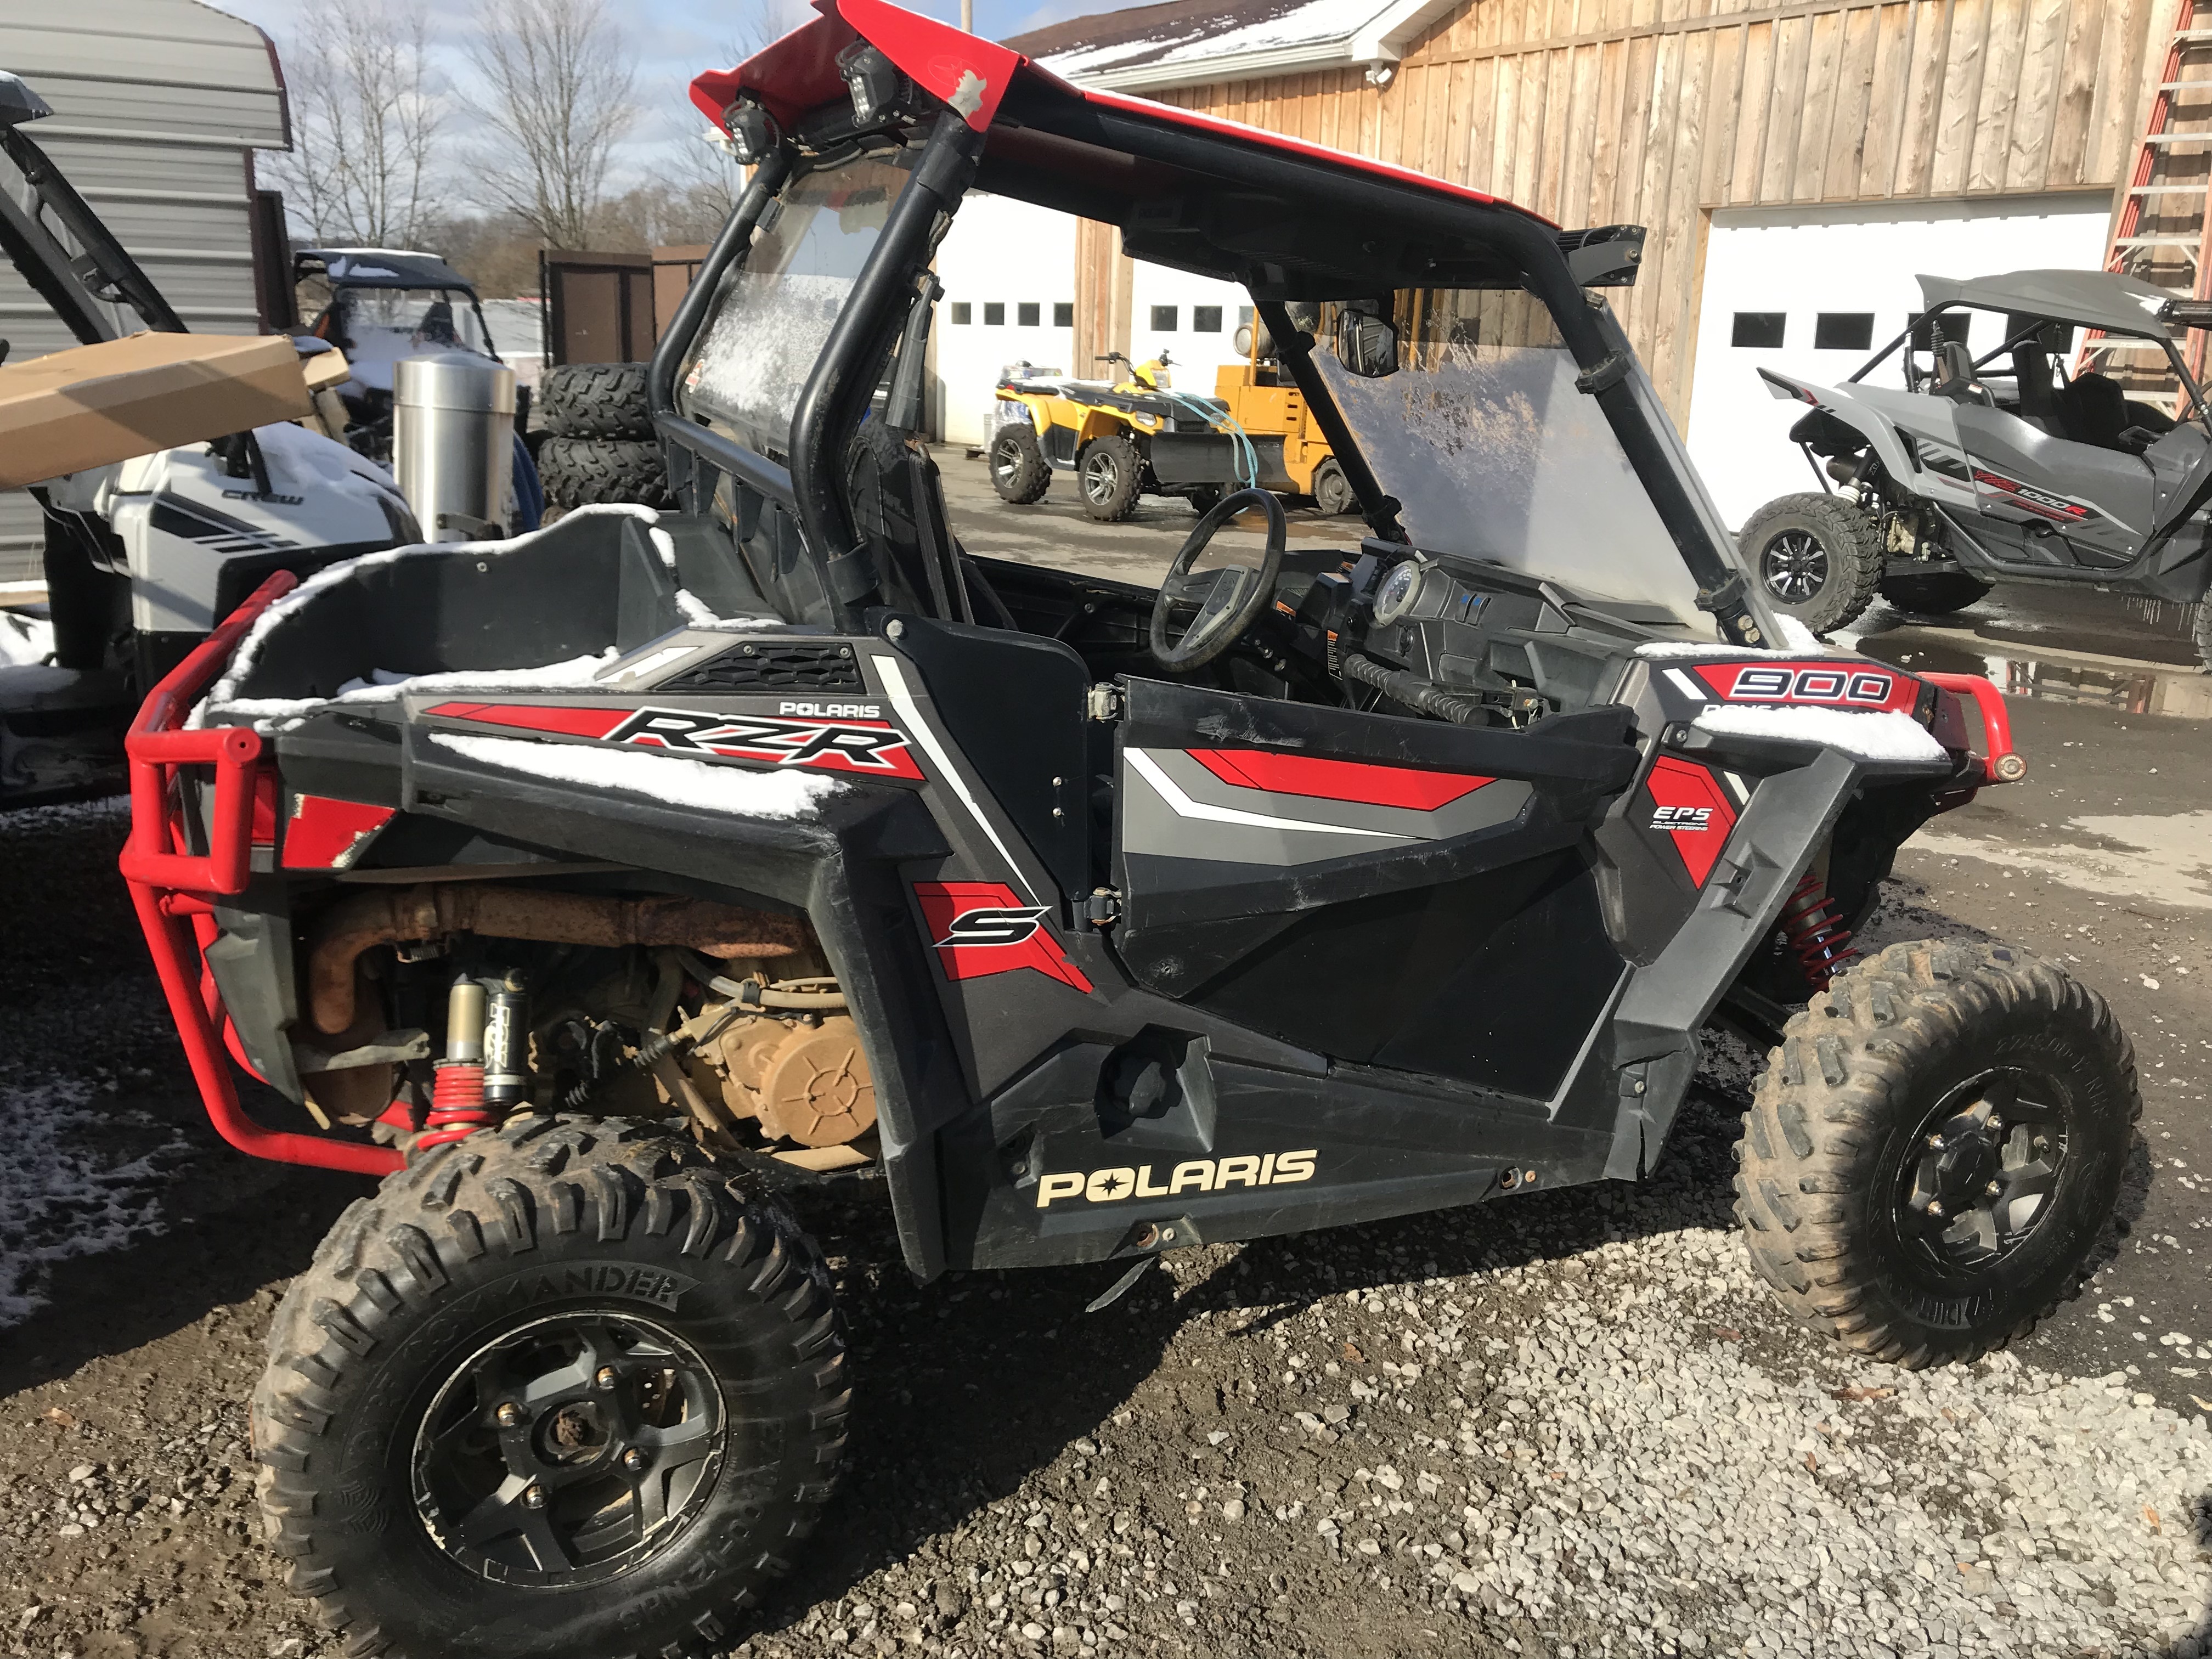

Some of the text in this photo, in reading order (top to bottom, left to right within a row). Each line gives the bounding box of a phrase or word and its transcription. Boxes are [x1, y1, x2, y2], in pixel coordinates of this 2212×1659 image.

[1728, 667, 1892, 704] 900
[779, 702, 880, 718] POLARIS
[601, 706, 911, 769] RZR
[1653, 806, 1713, 821] EPS
[932, 905, 1053, 948] S
[1036, 1149, 1318, 1207] POLARIS
